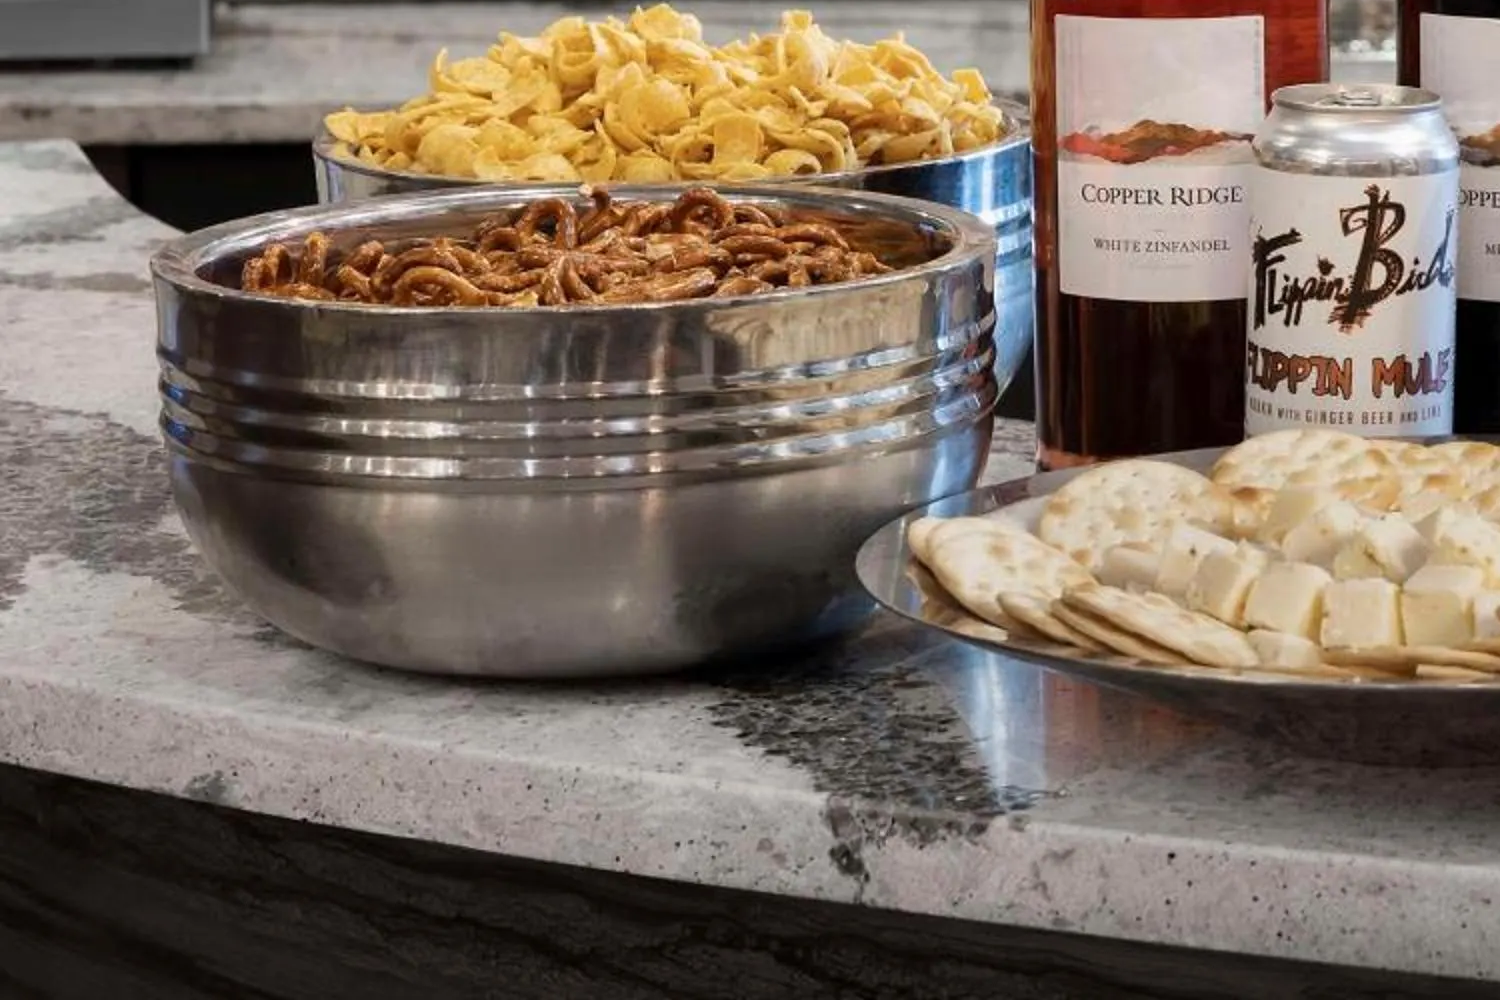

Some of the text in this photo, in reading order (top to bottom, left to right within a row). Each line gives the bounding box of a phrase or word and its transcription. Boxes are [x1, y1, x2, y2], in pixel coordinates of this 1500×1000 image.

[1081, 183, 1243, 207] COPPER RIDGE
[1093, 238, 1231, 253] WHITE ZINFANDEL
[1305, 409, 1354, 425] GINGER
[1361, 410, 1394, 425] BEER
